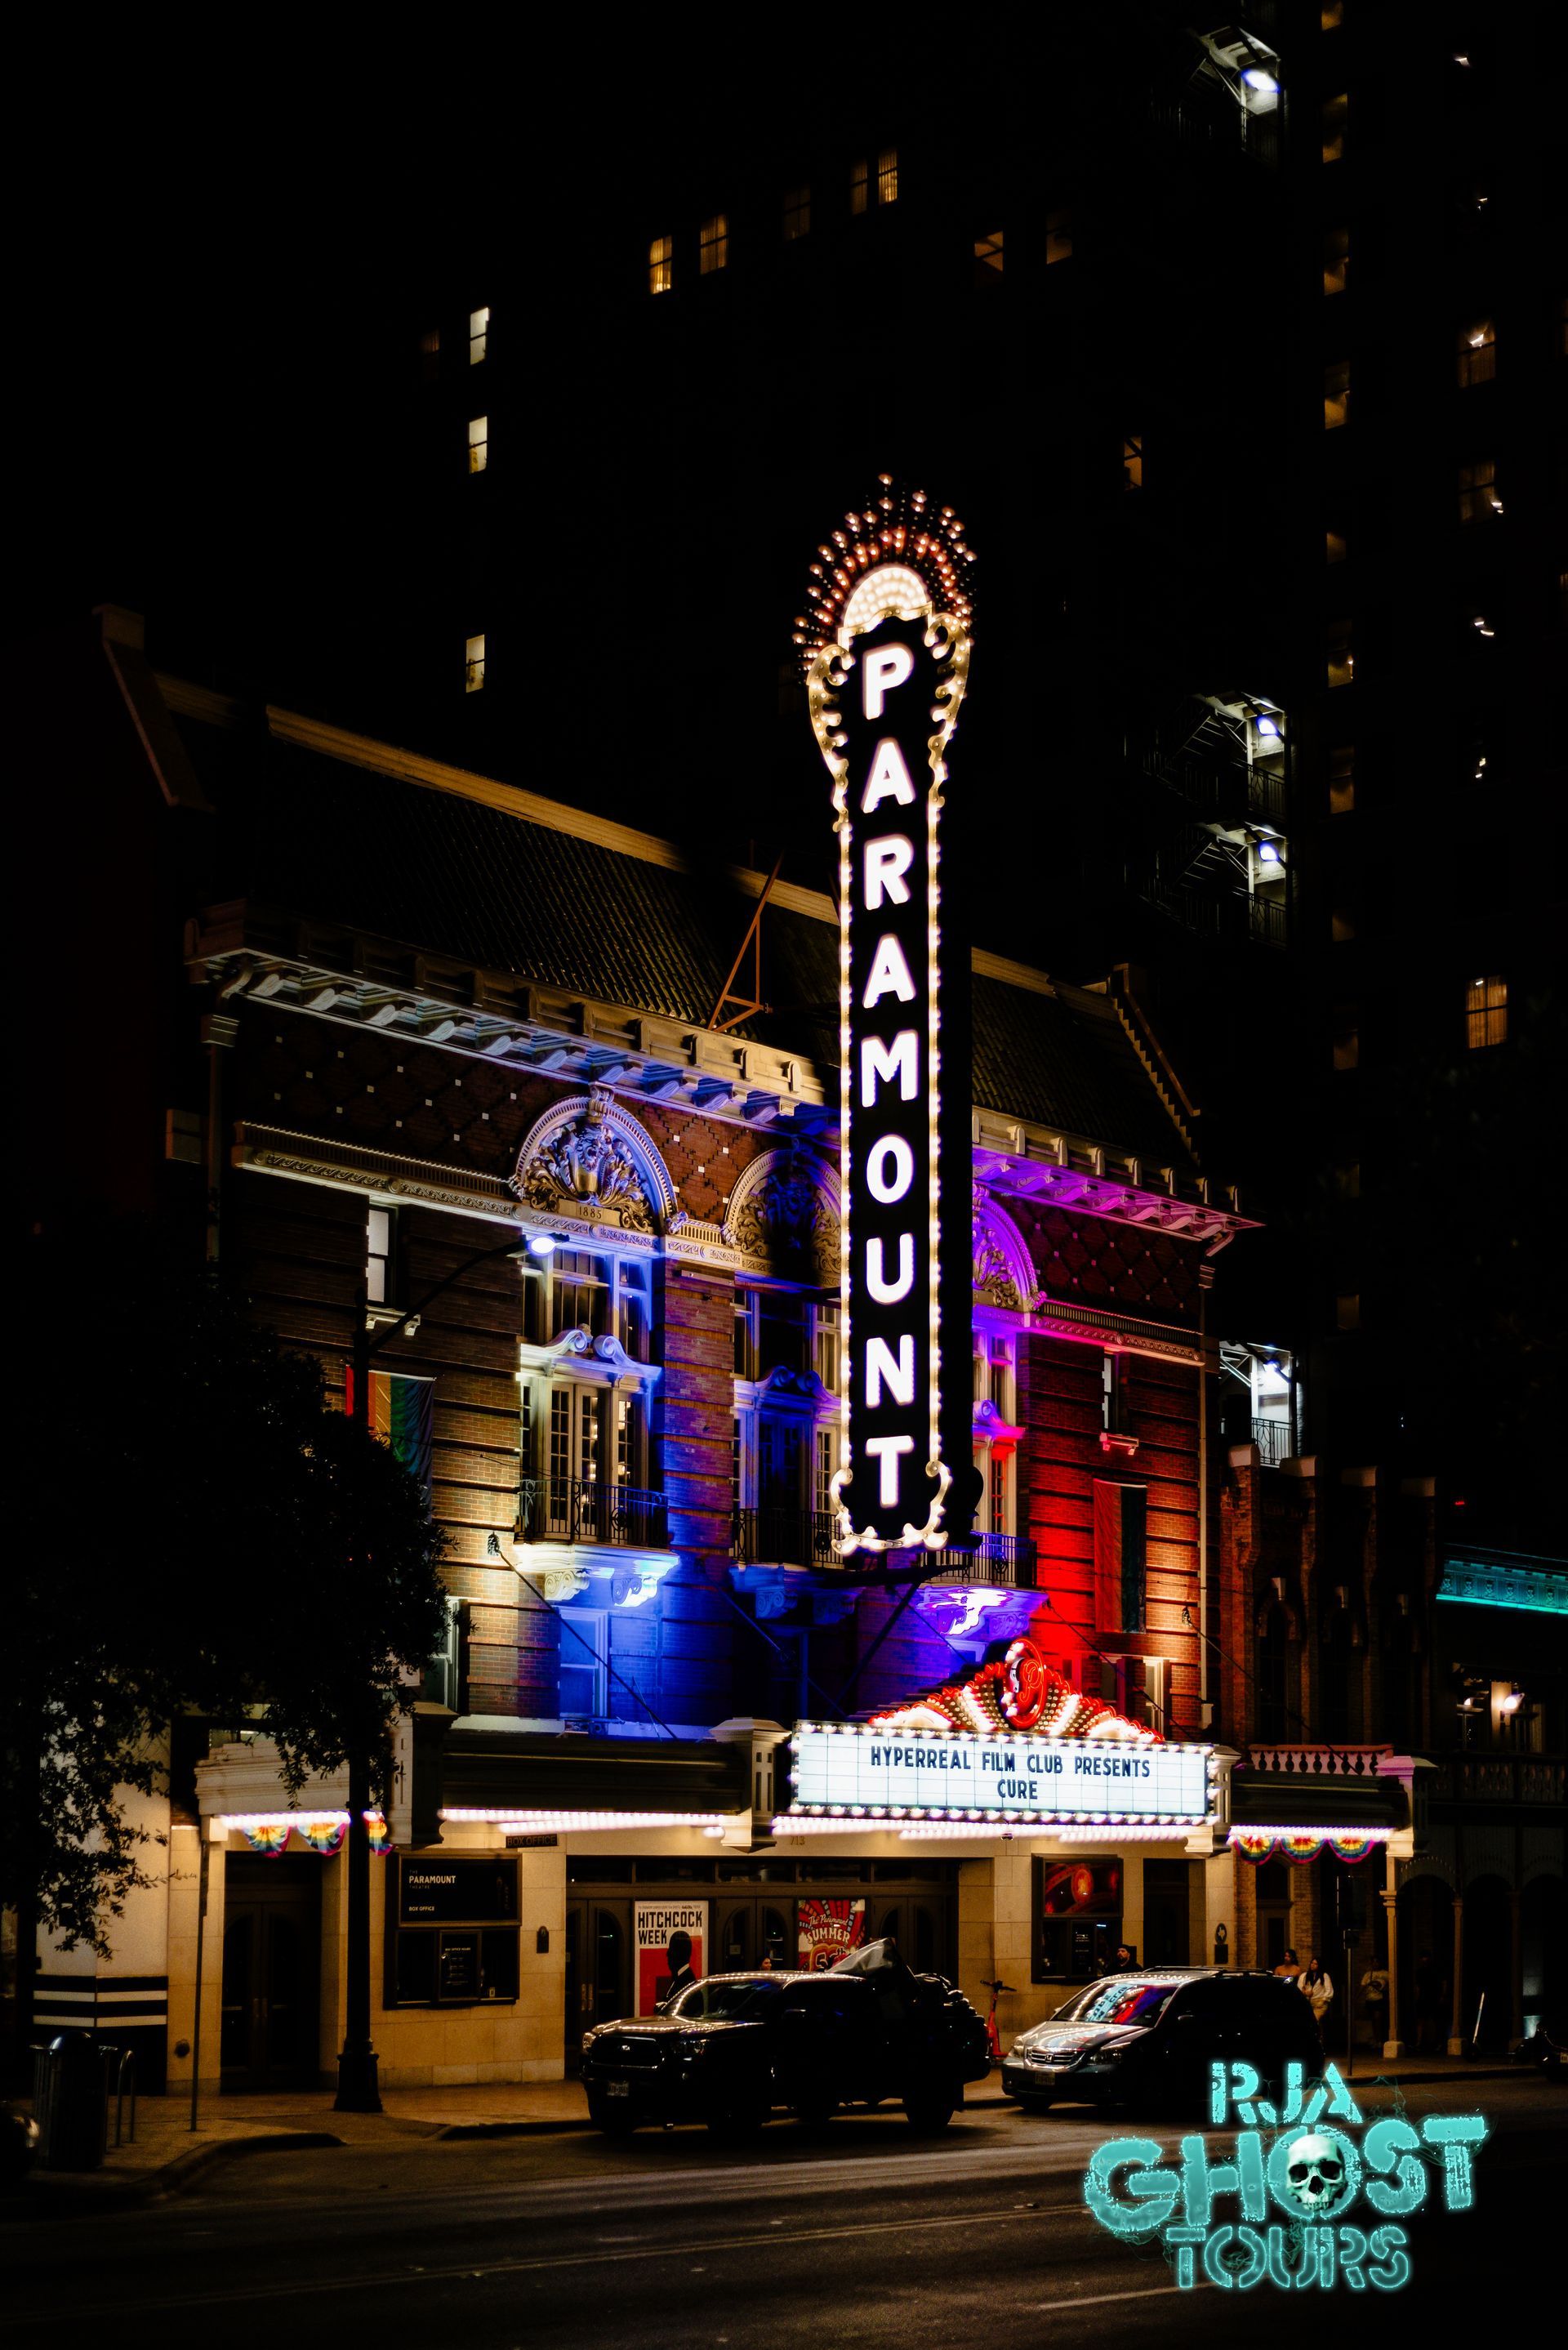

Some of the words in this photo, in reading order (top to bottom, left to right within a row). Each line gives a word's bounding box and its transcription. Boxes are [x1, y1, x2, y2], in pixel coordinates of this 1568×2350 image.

[862, 643, 917, 1509] PARAMOUNT
[579, 1206, 602, 1220] 1885
[871, 1746, 971, 1769] HYPERREAL
[982, 1751, 1015, 1772] FILM
[1027, 1754, 1063, 1774] CLUB
[1074, 1755, 1151, 1777] PRESENTS
[997, 1779, 1038, 1799] CURE
[507, 1837, 523, 1846] BOX
[526, 1835, 556, 1845] OFFICE
[791, 1836, 805, 1845] 713
[408, 1875, 457, 1884] PARAMOUNT
[638, 1911, 702, 1929] HITCHCOCK
[808, 1916, 819, 1927] The
[819, 1914, 849, 1926] Paramount
[638, 1929, 667, 1945] WEEK
[807, 1927, 850, 1944] SUMMER
